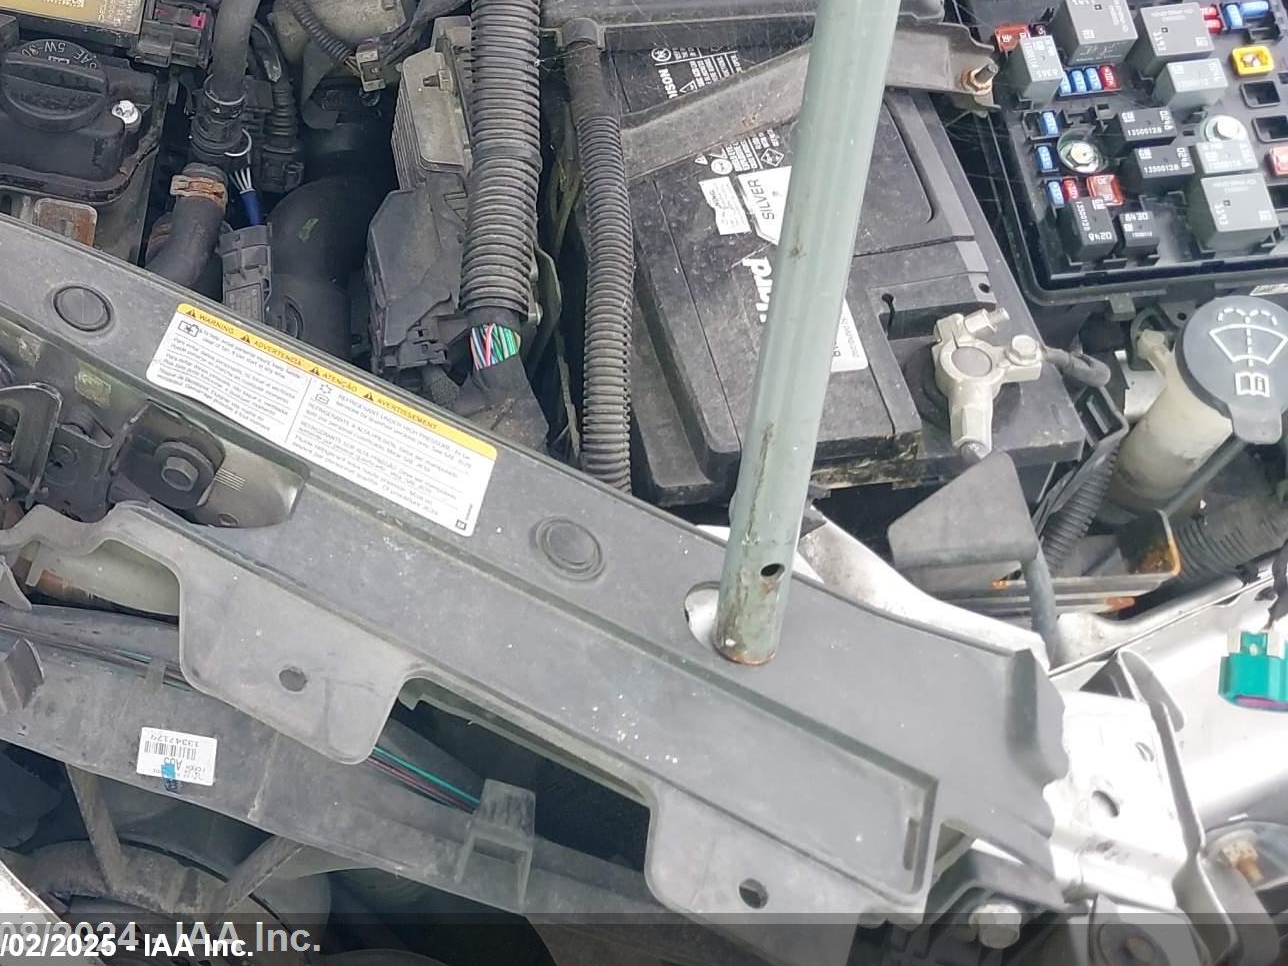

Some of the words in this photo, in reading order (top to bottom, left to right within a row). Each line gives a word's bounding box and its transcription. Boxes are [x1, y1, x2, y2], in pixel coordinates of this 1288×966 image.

[747, 178, 775, 222] SILVER
[198, 313, 234, 334] WARNING
[252, 340, 302, 366] ADVERTENCIA
